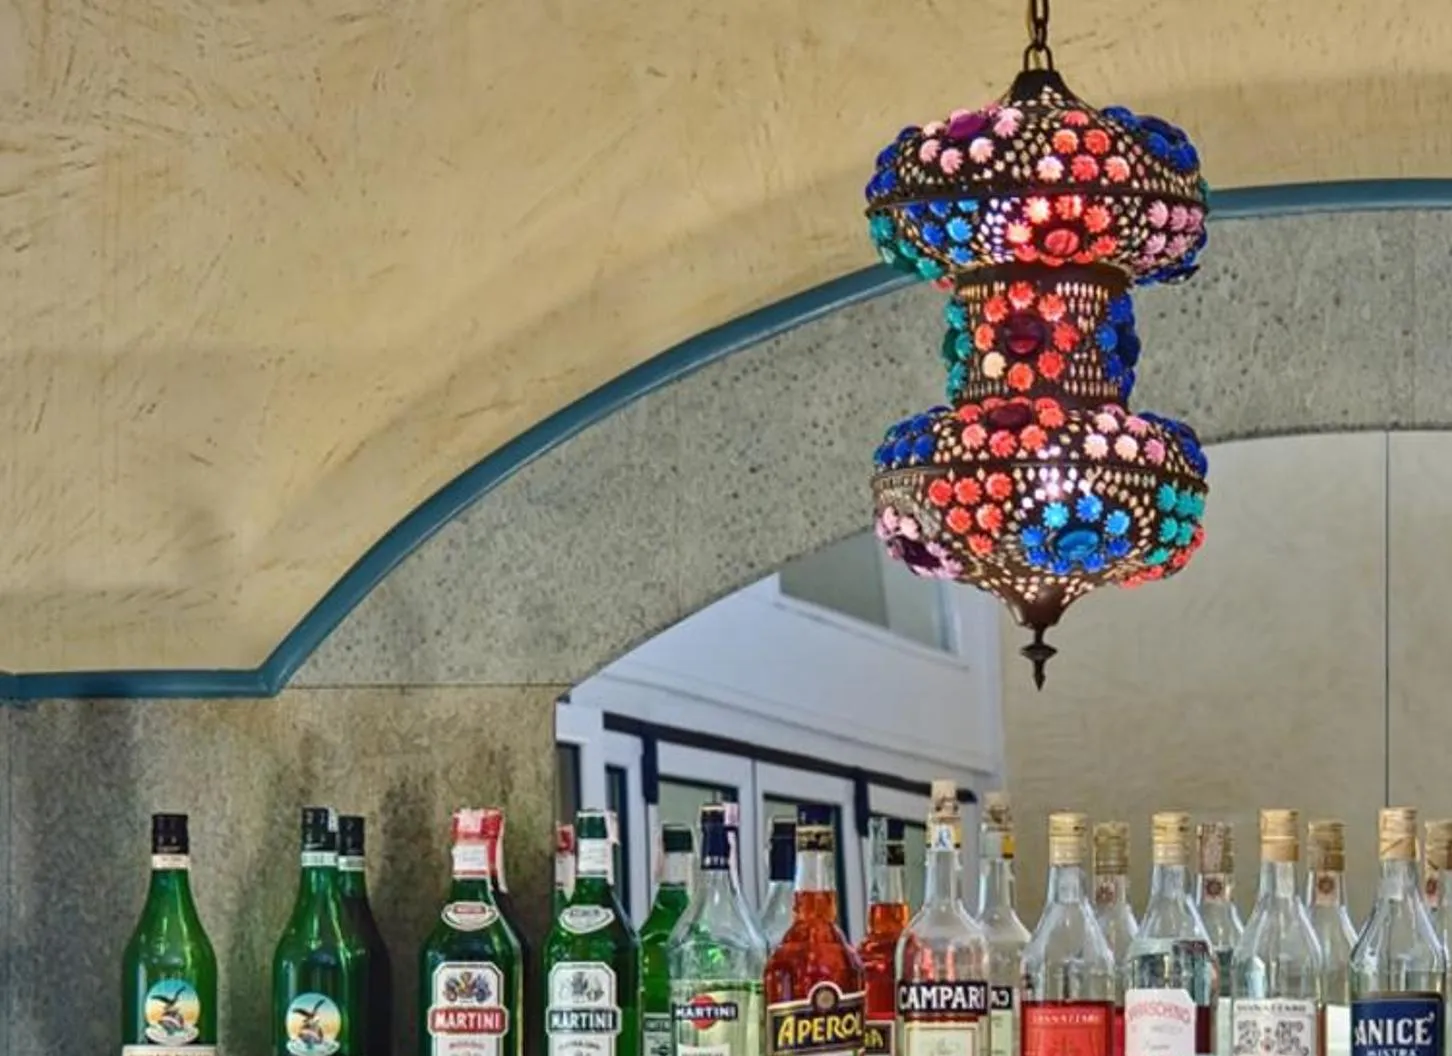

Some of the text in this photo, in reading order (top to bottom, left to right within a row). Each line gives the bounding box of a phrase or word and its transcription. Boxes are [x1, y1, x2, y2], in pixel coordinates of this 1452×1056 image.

[900, 985, 984, 1010] CAMPARI
[434, 1010, 500, 1029] MARTINI
[551, 1009, 613, 1029] MARTINI
[675, 1004, 737, 1020] MARTINI
[778, 1012, 862, 1047] APEROL
